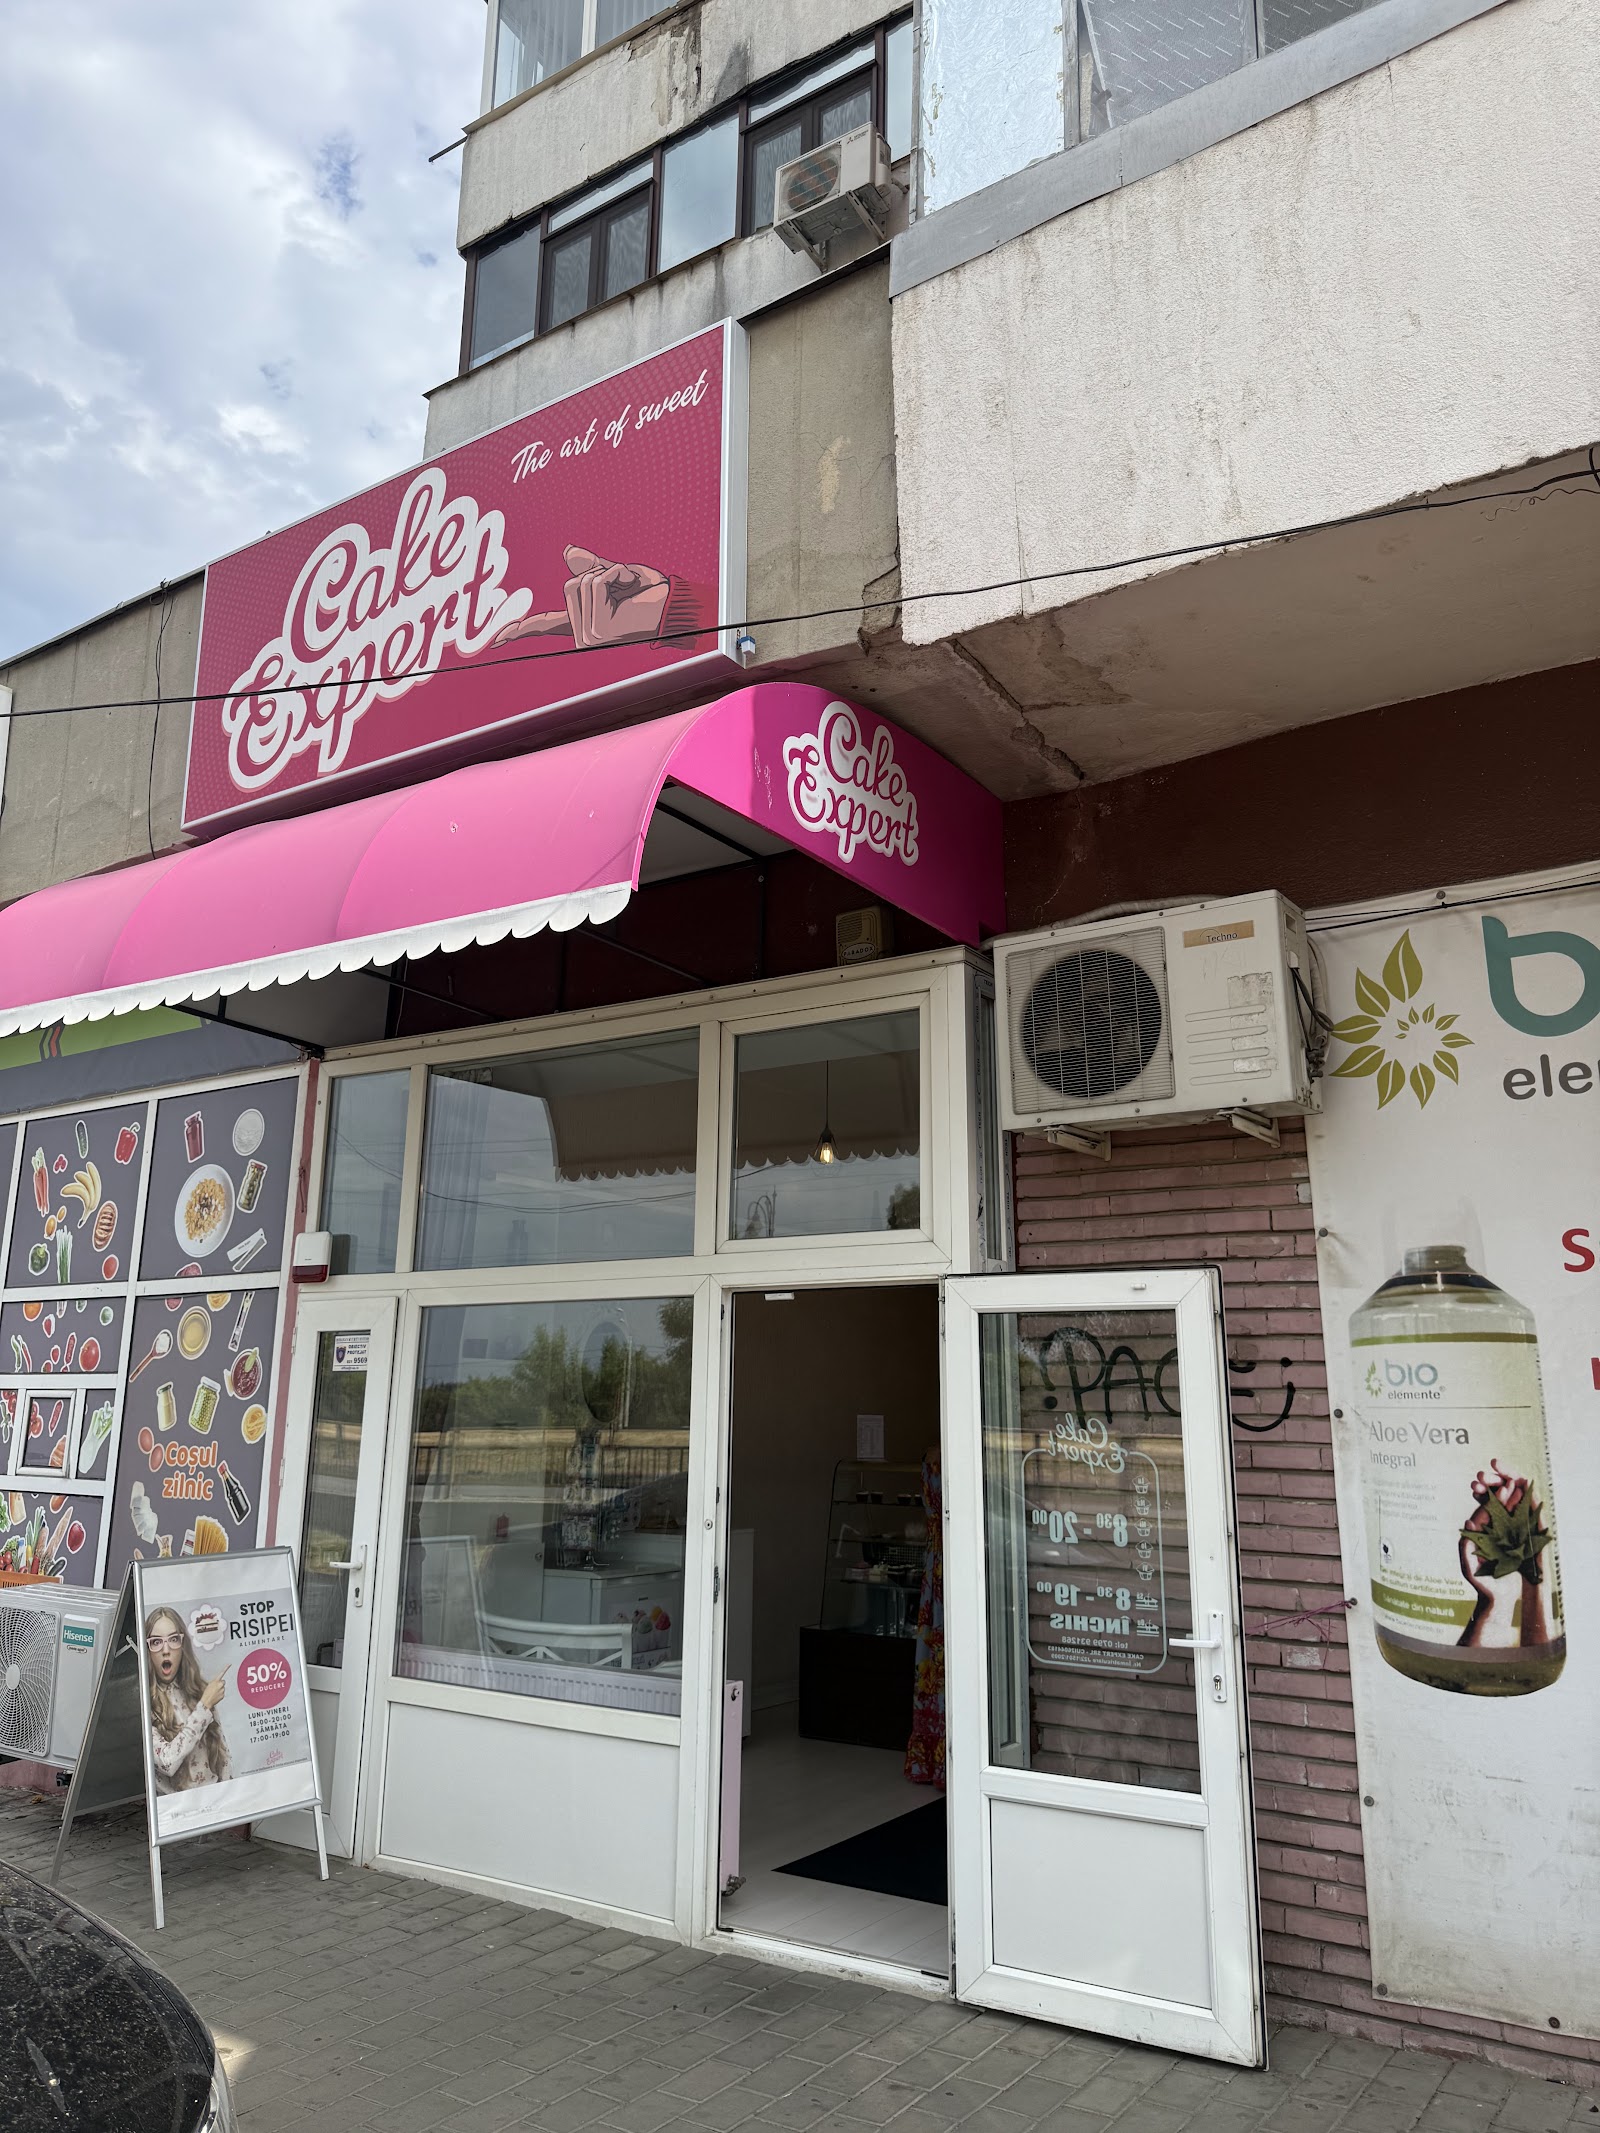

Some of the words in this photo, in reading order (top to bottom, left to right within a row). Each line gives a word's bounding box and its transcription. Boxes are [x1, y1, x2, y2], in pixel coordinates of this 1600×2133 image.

[511, 441, 553, 483] The
[560, 418, 598, 458] art
[604, 404, 630, 449] of
[635, 369, 709, 430] sweet
[286, 478, 472, 666] Cake
[226, 522, 500, 784] Expert
[822, 711, 905, 808] Cake
[787, 743, 916, 859] Expert
[1206, 932, 1238, 943] Techno
[843, 946, 873, 957] PARADOX
[1503, 1053, 1600, 1100] ele
[1384, 1358, 1438, 1386] bio
[1388, 1390, 1441, 1399] elemente
[1369, 1420, 1408, 1443] Aloe
[1408, 1421, 1470, 1445] Vera
[165, 1441, 218, 1475] Coșul
[1370, 1450, 1416, 1469] Integral
[162, 1471, 214, 1501] zilnic
[240, 1601, 274, 1615] STOP
[64, 1629, 93, 1643] Hisense
[230, 1613, 294, 1640] RISIPEI
[240, 1635, 285, 1647] ALIMENTARE
[247, 1661, 287, 1685] 50%
[251, 1682, 285, 1693] REDUCERE
[248, 1706, 289, 1719] LUNI-VINERI
[250, 1714, 292, 1727] 18:00-20:00
[250, 1730, 290, 1743] 17:00-19:00
